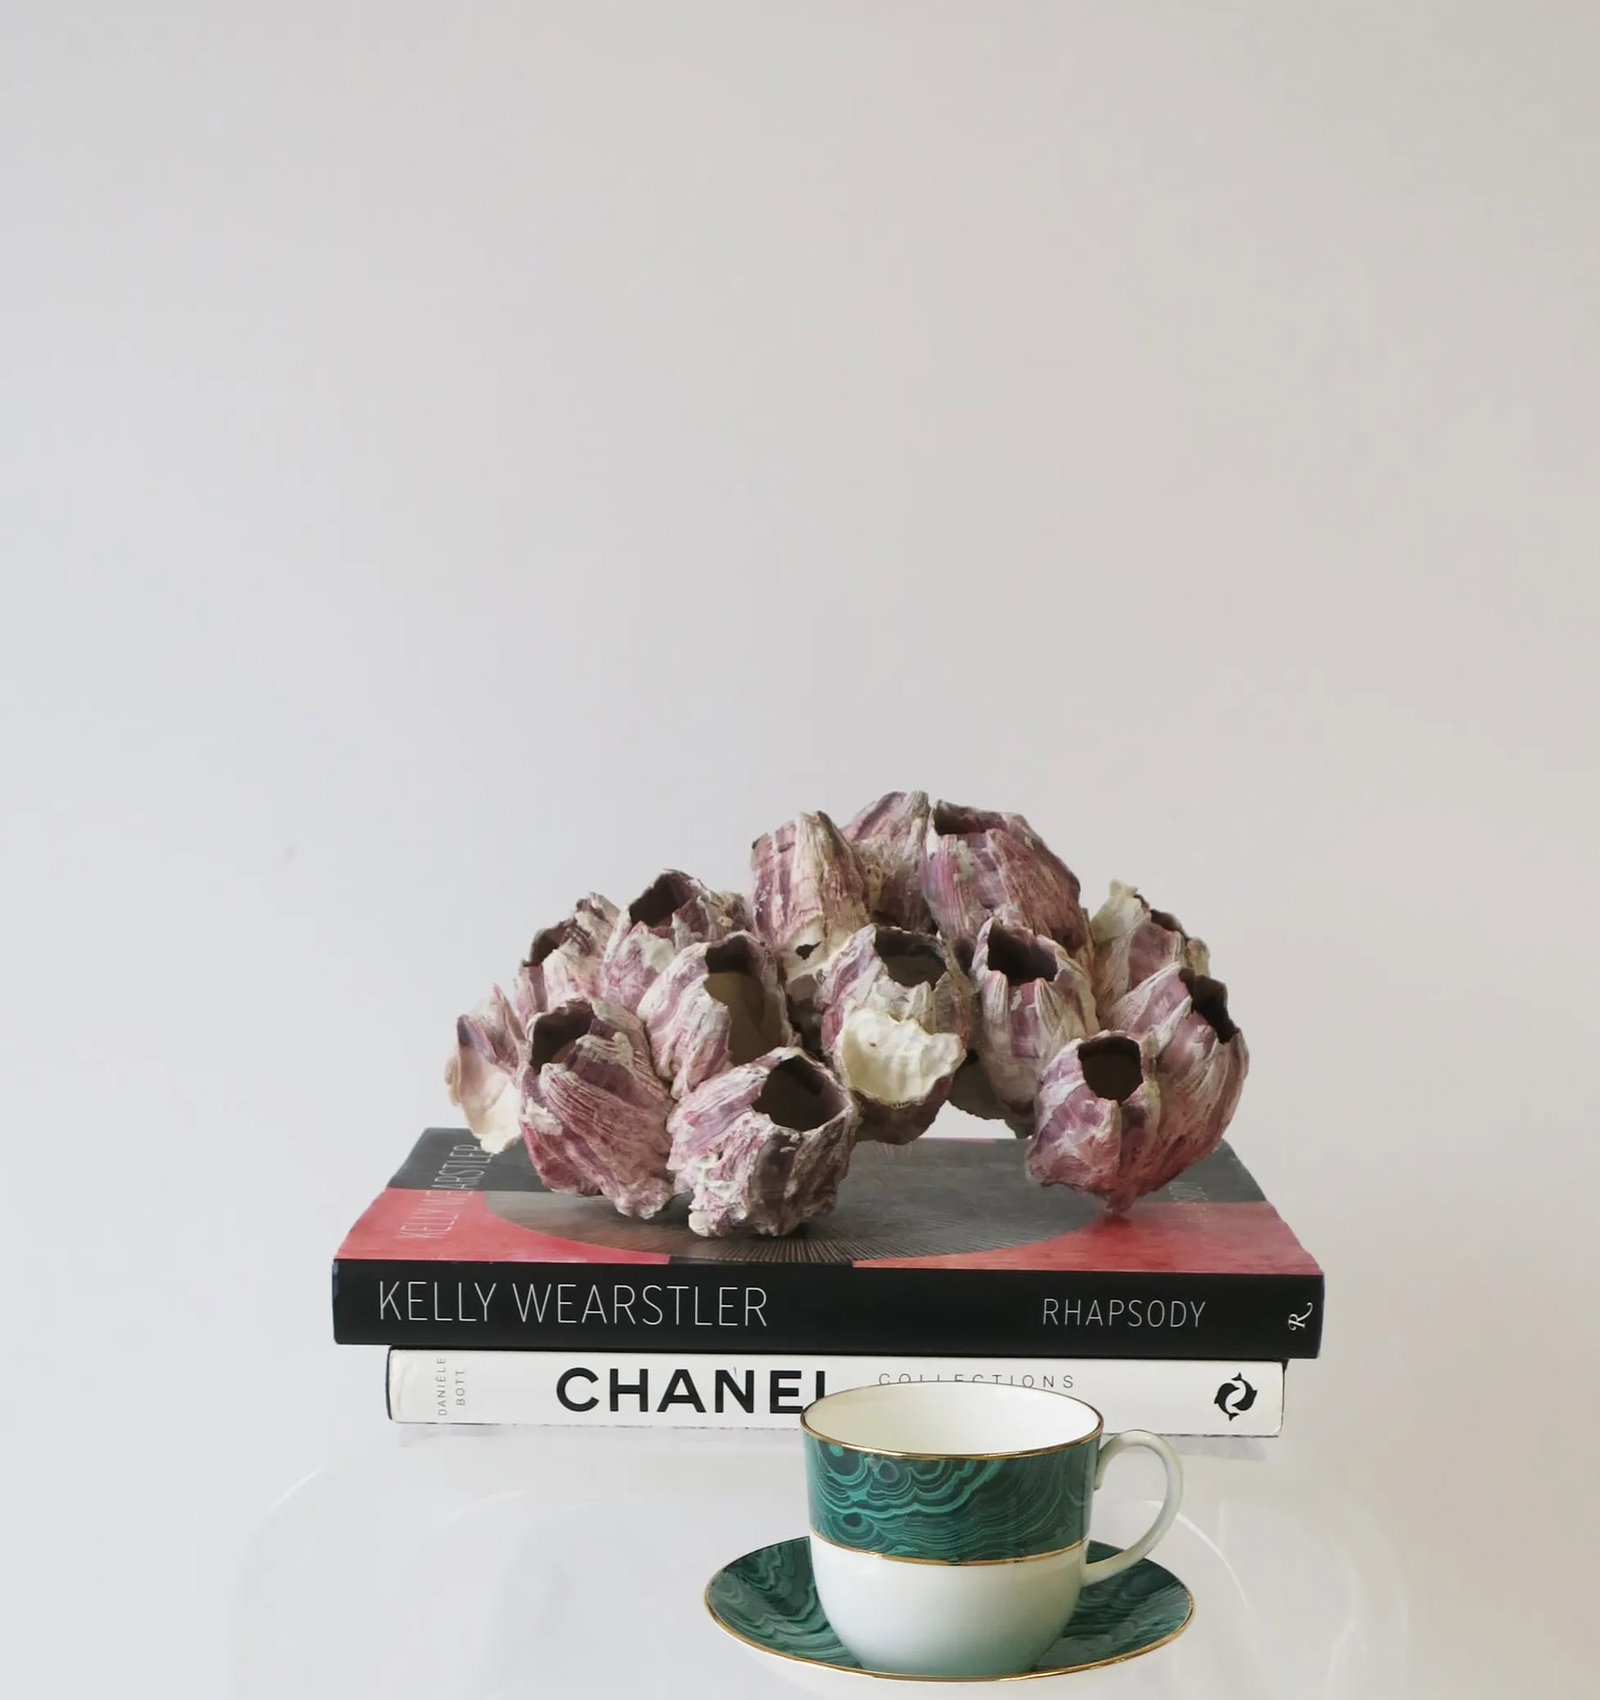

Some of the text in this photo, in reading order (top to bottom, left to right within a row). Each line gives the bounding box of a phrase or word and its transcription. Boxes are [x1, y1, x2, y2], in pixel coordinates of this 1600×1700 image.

[420, 1144, 494, 1205] WEARSTLER
[379, 1280, 767, 1327] KELLY WEARSTLER
[1043, 1298, 1206, 1328] RHAPSODY
[455, 1370, 465, 1406] BOTT
